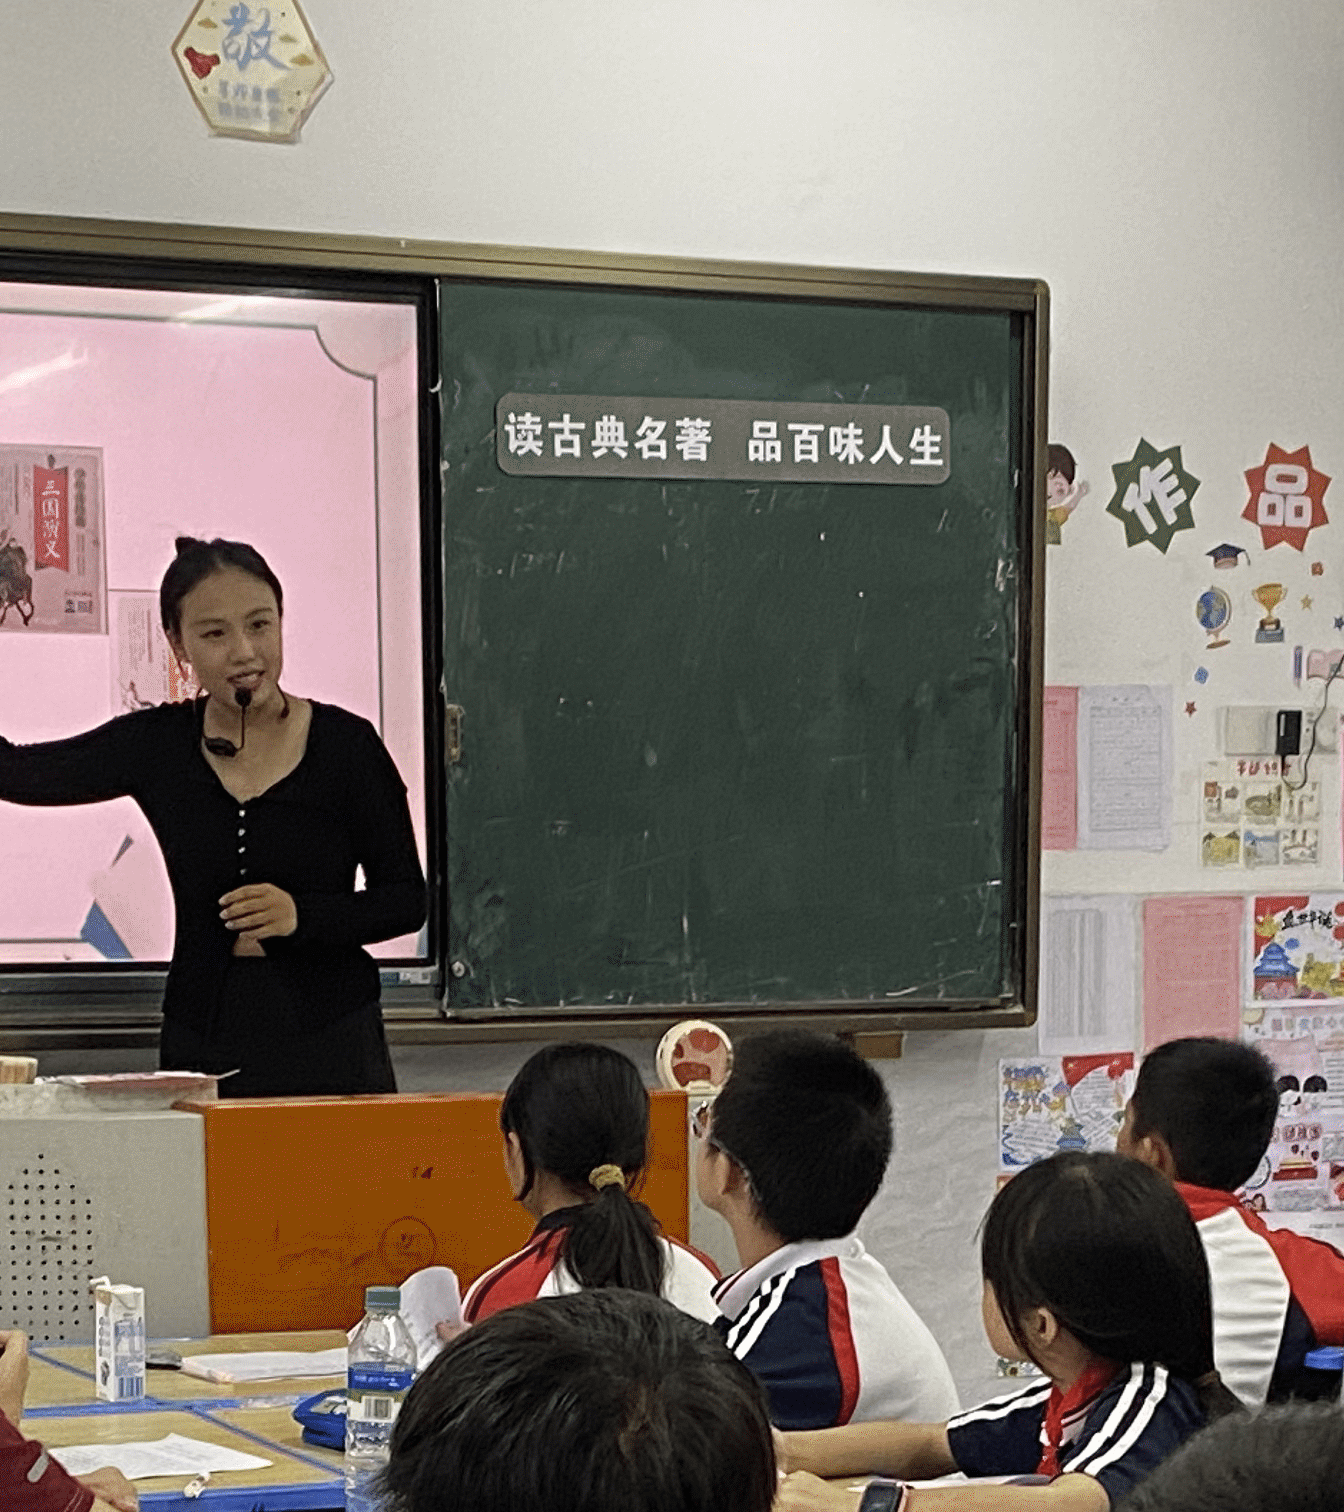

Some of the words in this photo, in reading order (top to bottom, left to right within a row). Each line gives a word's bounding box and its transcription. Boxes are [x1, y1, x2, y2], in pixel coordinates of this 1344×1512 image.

[504, 412, 712, 461] 读古典名著
[748, 420, 944, 466] 品百味人生
[41, 480, 61, 560] 三国演义
